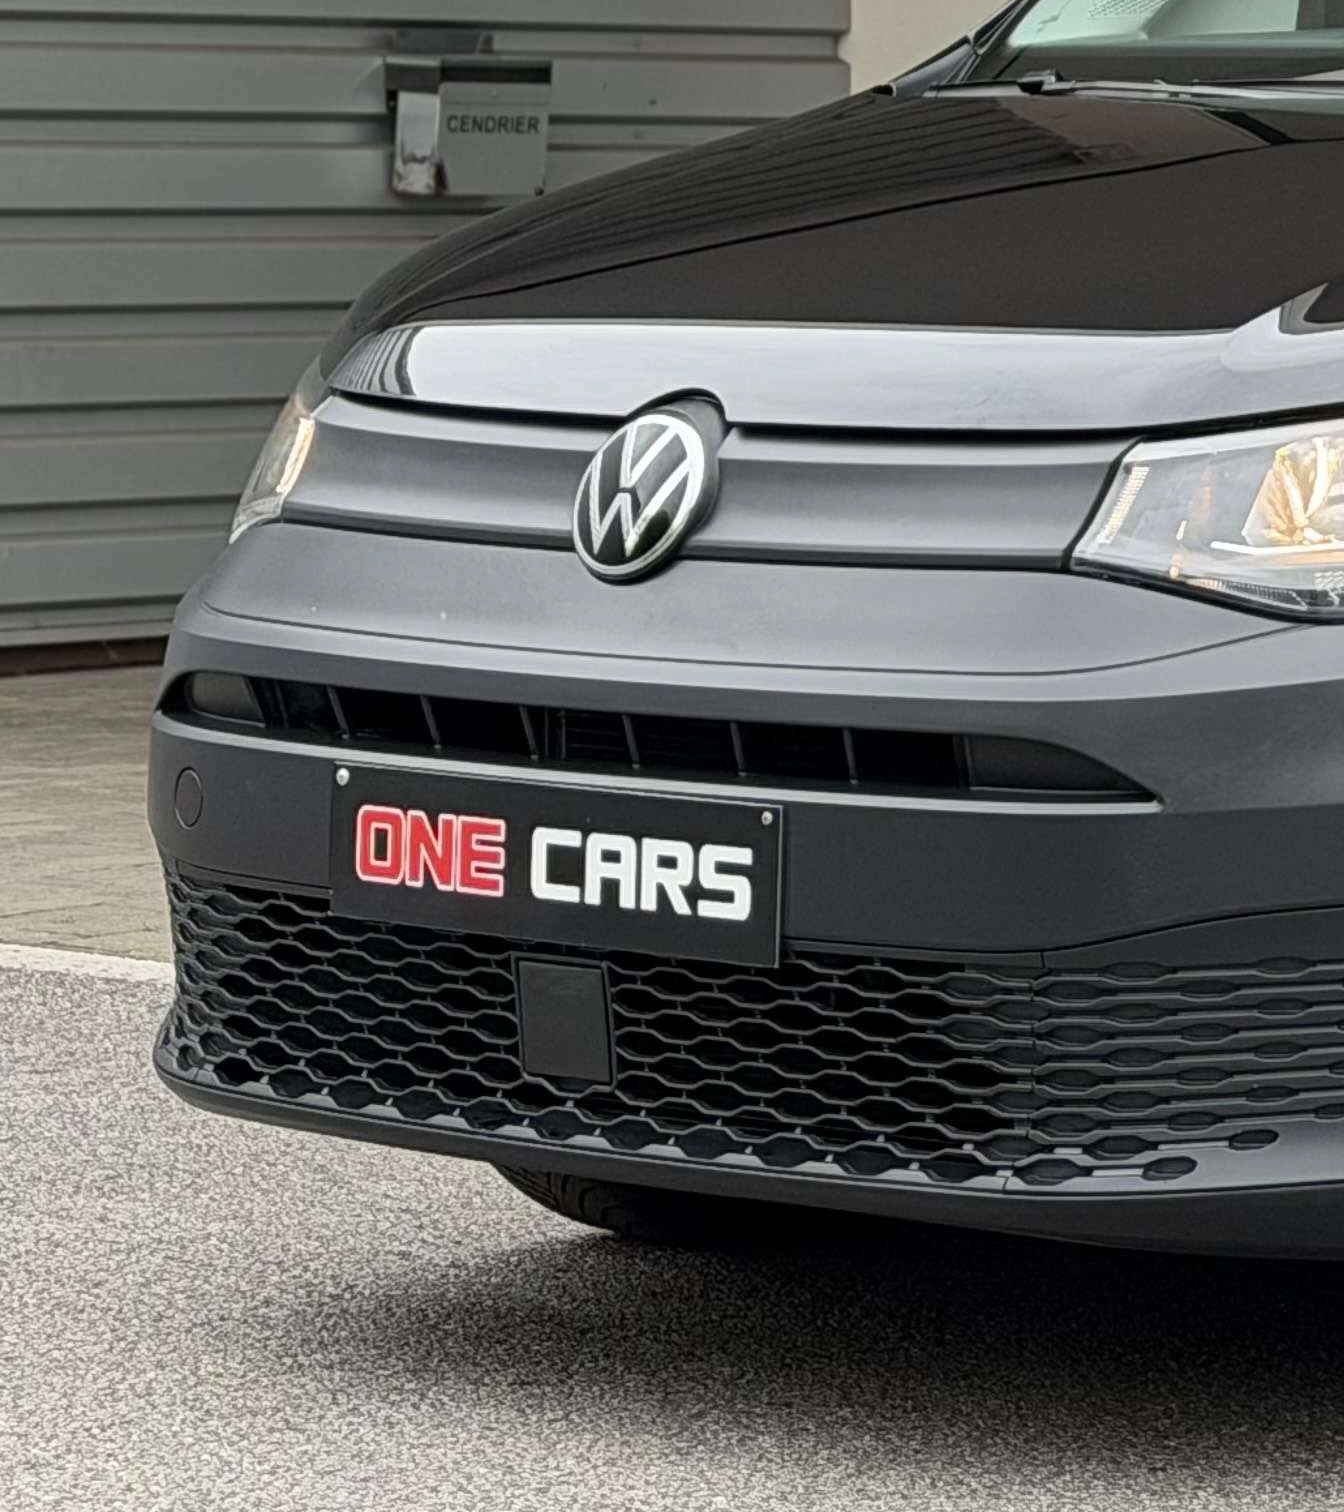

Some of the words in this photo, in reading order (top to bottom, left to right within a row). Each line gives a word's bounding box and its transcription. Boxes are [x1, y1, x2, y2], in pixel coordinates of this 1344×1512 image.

[446, 114, 540, 135] CENDRIER
[355, 804, 506, 898] ONE
[530, 826, 753, 922] CARS
